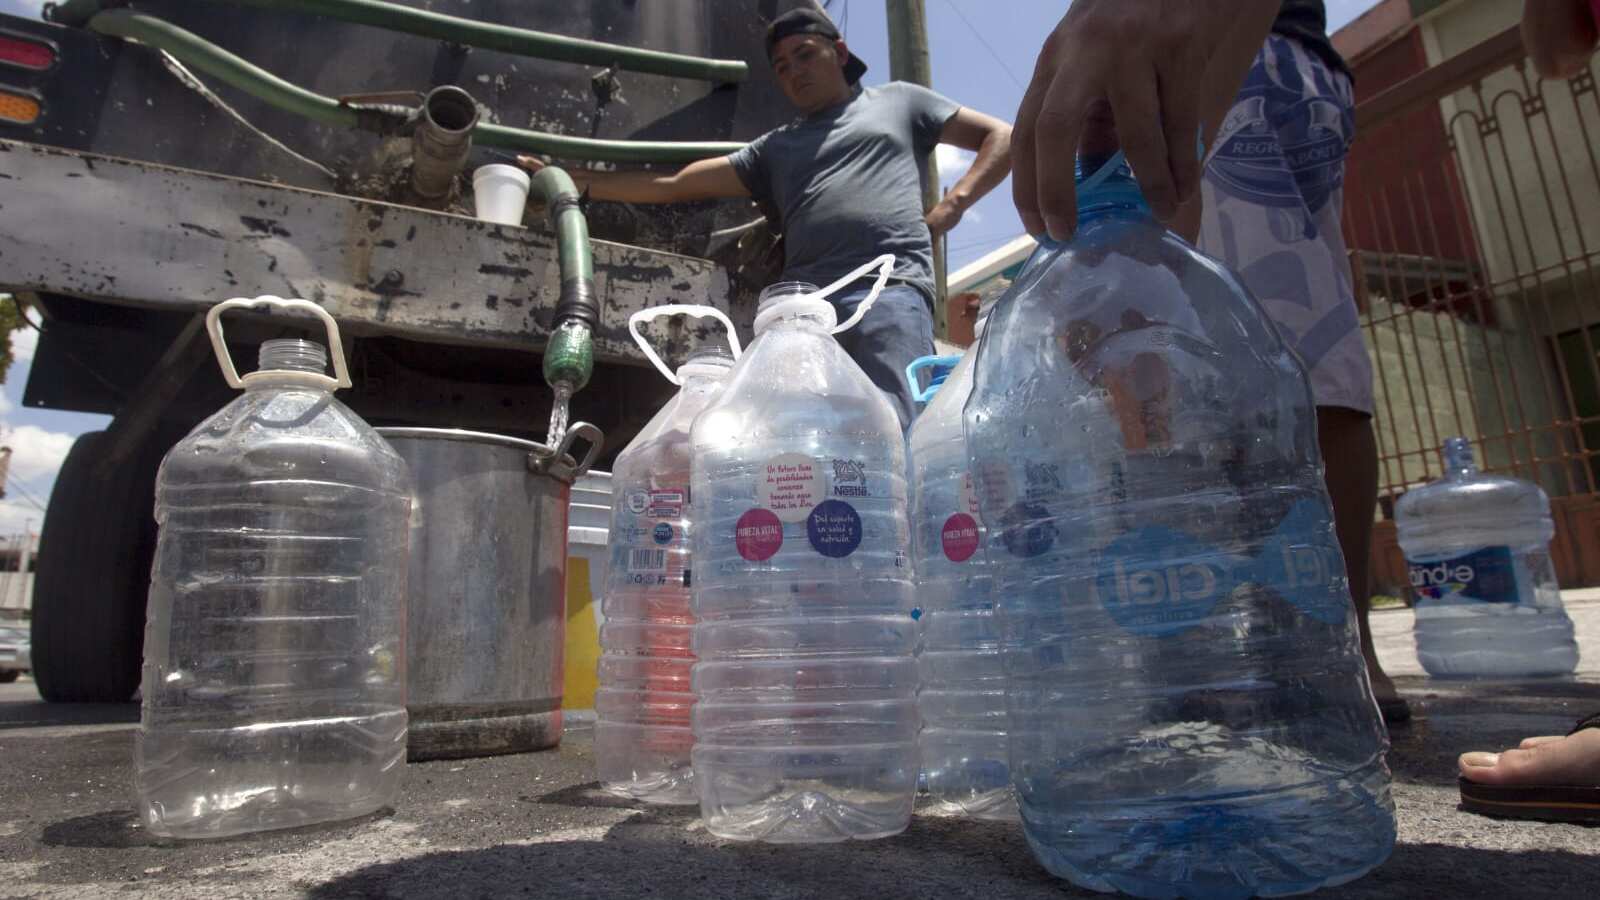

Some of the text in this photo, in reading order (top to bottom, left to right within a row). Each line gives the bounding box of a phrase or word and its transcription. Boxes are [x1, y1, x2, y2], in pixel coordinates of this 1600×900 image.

[767, 465, 776, 473] Un
[767, 474, 775, 482] de
[833, 485, 867, 497] Nestlé
[815, 514, 827, 523] Del
[737, 524, 778, 537] PUREZA VITAL
[827, 525, 846, 533] salud
